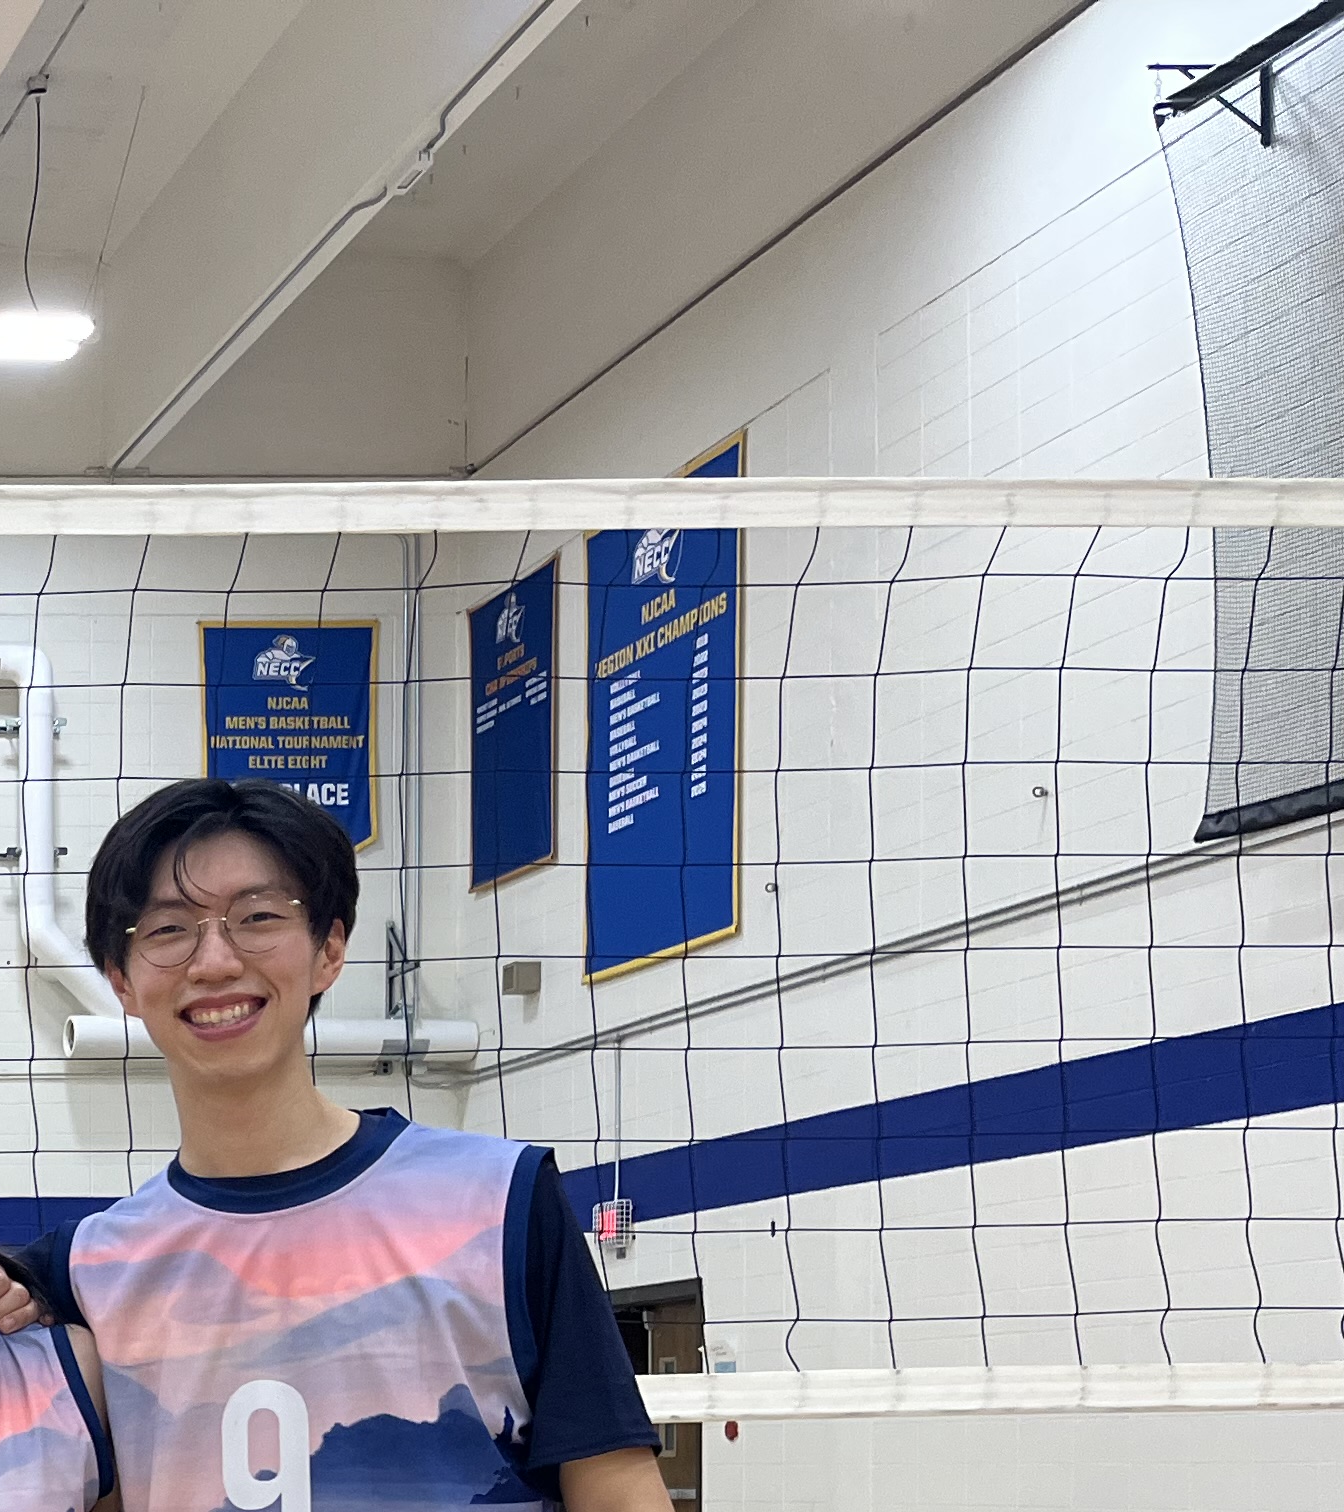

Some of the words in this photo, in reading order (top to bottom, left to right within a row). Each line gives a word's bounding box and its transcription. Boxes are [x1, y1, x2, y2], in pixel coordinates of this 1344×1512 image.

[634, 540, 670, 579] NECC
[641, 588, 676, 625] NJCAA
[635, 631, 656, 661] XXI
[657, 592, 727, 648] CHAMPIONS
[256, 662, 301, 677] NECC
[267, 697, 309, 710] NJCAA
[225, 716, 266, 729] MEN'S
[210, 735, 275, 749] NATIONAL
[277, 735, 365, 749] TOURNAMENT
[248, 755, 285, 769] ELITE
[287, 755, 328, 769] EIGHT
[279, 783, 350, 806] ACE
